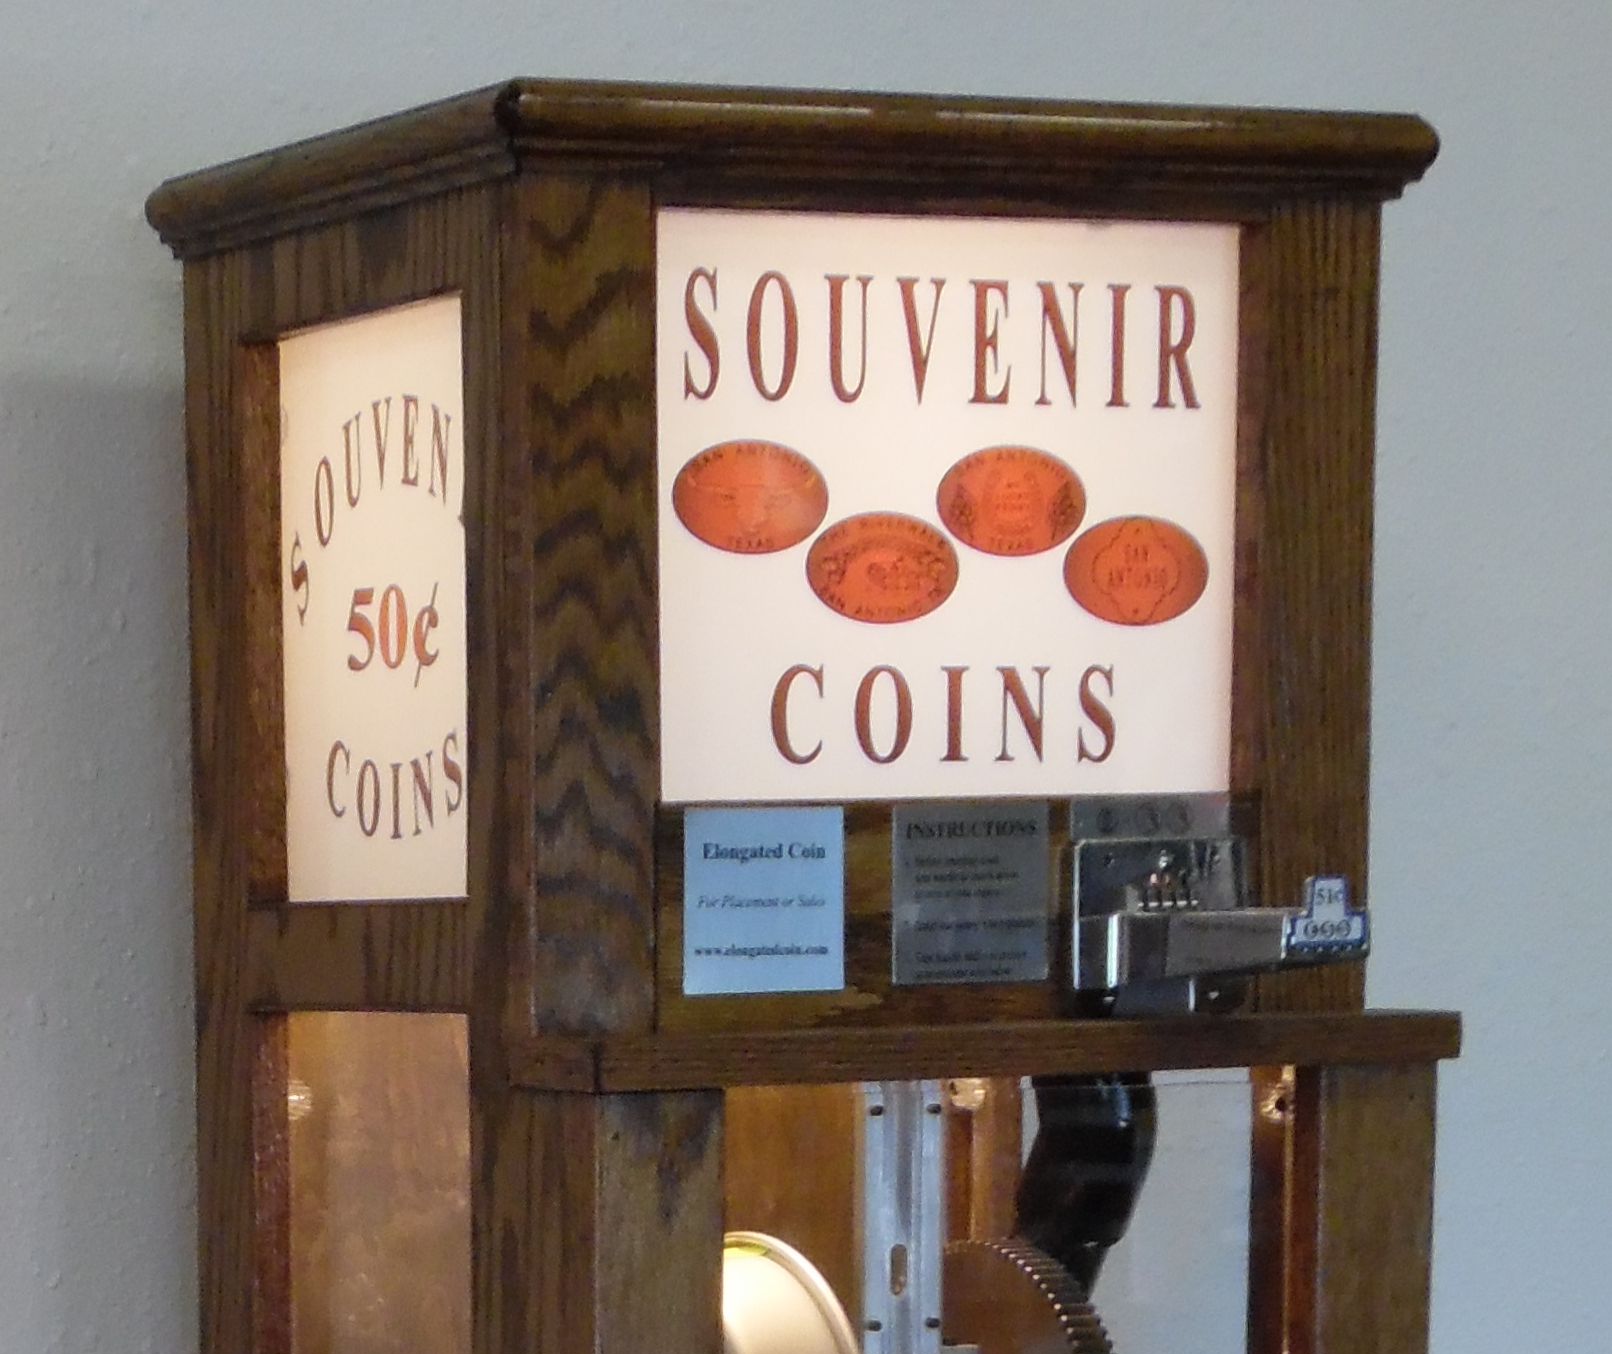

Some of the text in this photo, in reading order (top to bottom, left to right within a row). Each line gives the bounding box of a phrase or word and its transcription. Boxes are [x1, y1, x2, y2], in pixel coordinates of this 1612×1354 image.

[683, 266, 1201, 409] SOUVENIR
[290, 394, 452, 627] SOUVEN
[346, 582, 440, 689] 50¢
[770, 663, 1117, 766] COINS
[326, 727, 463, 840] COINS
[905, 818, 1038, 840] INSTRUCTIONS
[702, 842, 827, 864] Elongated Coin
